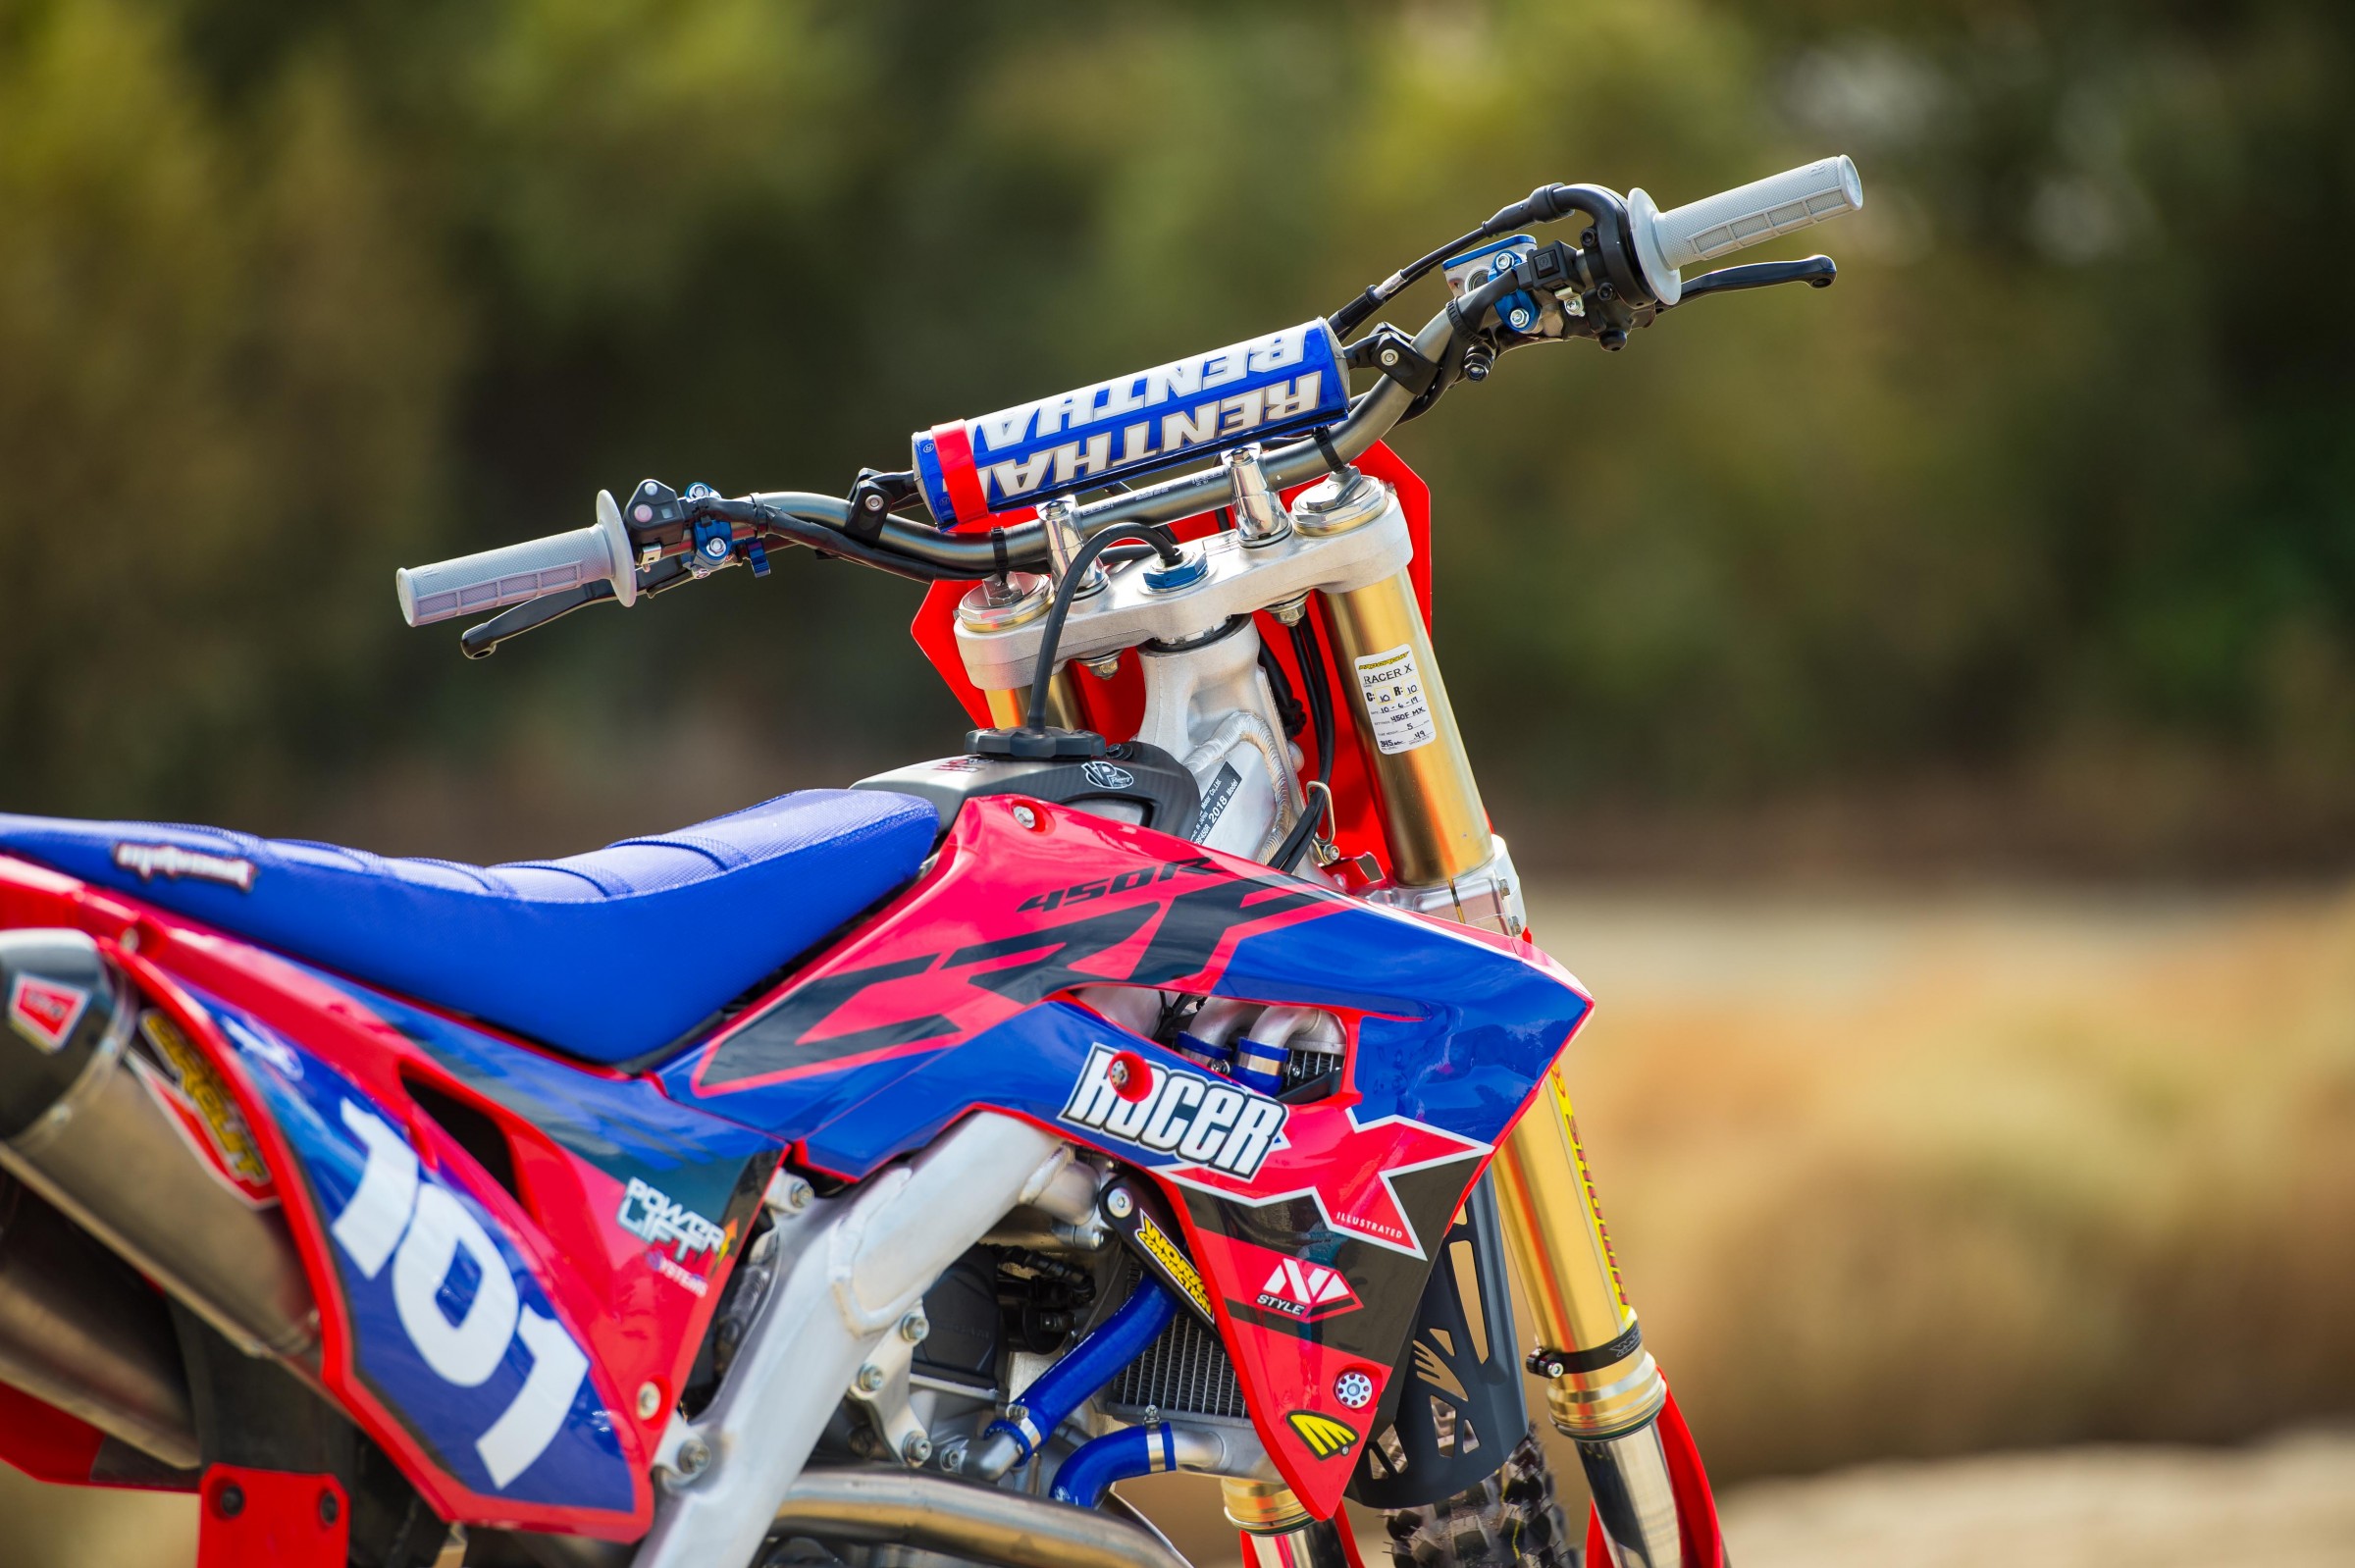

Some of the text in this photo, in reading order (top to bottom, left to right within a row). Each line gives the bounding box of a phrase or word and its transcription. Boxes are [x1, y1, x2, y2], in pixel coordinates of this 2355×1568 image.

[954, 329, 1307, 453] RENTHA
[1364, 663, 1412, 685] RACER X
[1380, 694, 1391, 704] 10
[1407, 684, 1418, 694] 10
[1391, 712, 1410, 723] 450F
[1412, 706, 1426, 716] MX
[1407, 722, 1414, 731] 5
[1081, 761, 1117, 785] VP
[1201, 796, 1211, 810] Motor
[1208, 796, 1228, 823] 2018
[1226, 780, 1238, 796] Model
[1017, 858, 1224, 913] 450R
[616, 1200, 693, 1260] LIFT
[1335, 1212, 1404, 1239] ILLUSTRATED
[1139, 1230, 1211, 1314] CONNECTION
[1146, 1217, 1214, 1302] WORK
[332, 1097, 590, 1490] 101
[1257, 1294, 1303, 1315] STYLE
